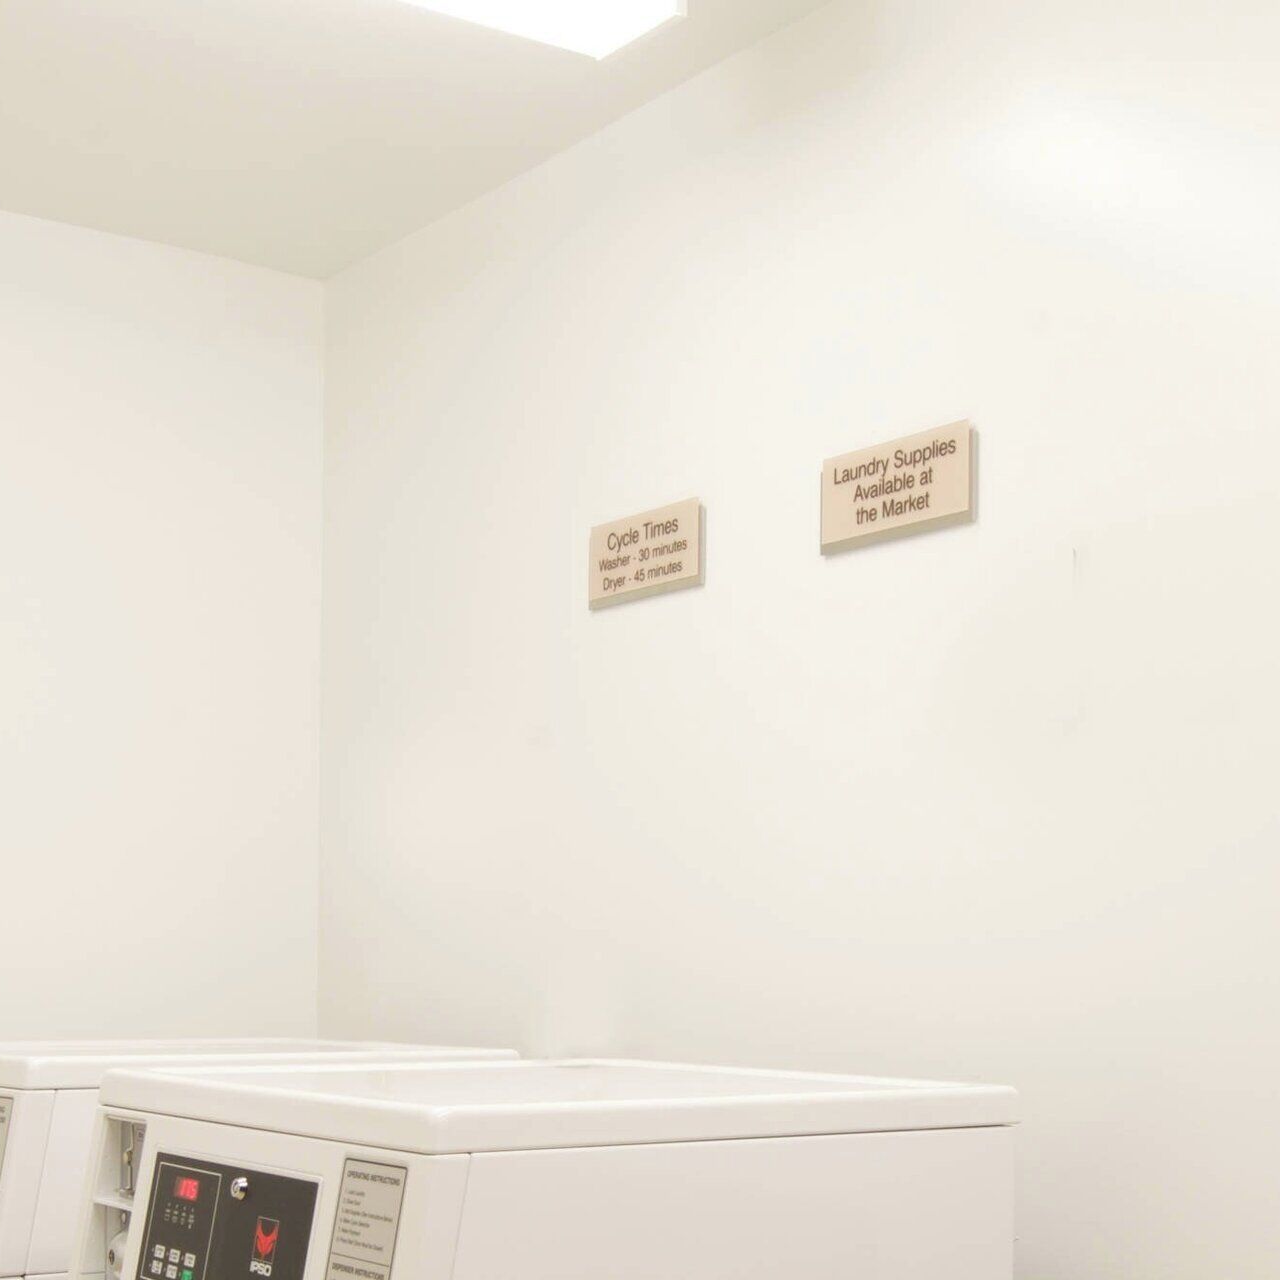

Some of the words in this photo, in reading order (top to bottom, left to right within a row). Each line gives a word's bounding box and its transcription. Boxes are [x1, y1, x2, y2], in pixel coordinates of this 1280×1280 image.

[833, 457, 889, 485] Laundry
[894, 439, 957, 469] Supplies
[853, 472, 915, 502] Available
[919, 466, 933, 486] at
[856, 507, 878, 525] the
[882, 491, 930, 519] Market
[607, 527, 640, 553] Cycle
[643, 518, 679, 540] Times
[599, 554, 631, 572] Washer
[638, 547, 650, 562] 30
[652, 539, 687, 559] minutes
[602, 575, 626, 592] Dryer
[633, 567, 646, 582] 45
[647, 560, 683, 580] minutes
